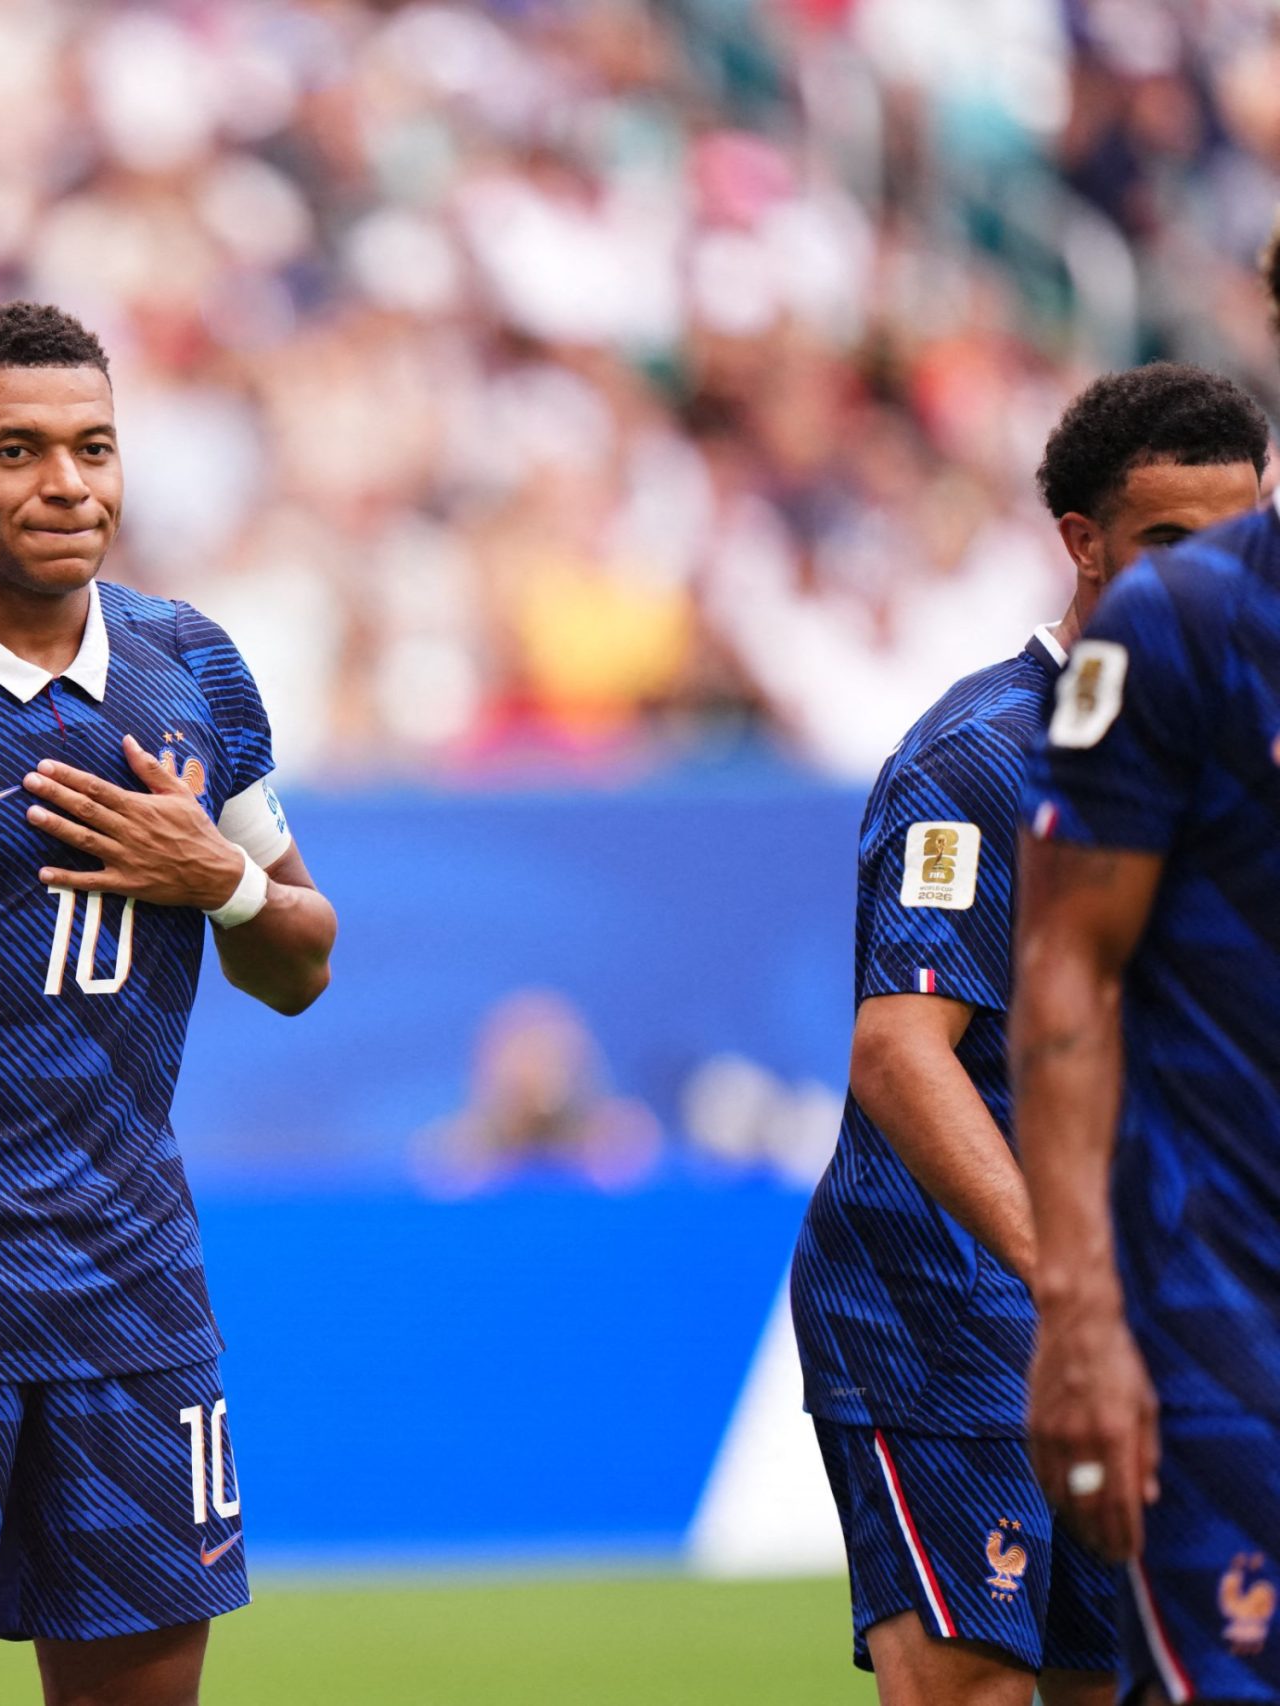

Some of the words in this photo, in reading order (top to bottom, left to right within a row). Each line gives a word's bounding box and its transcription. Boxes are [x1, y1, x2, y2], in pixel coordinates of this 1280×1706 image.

[43, 885, 135, 995] 10
[918, 891, 953, 902] 2026
[179, 1398, 240, 1525] 10
